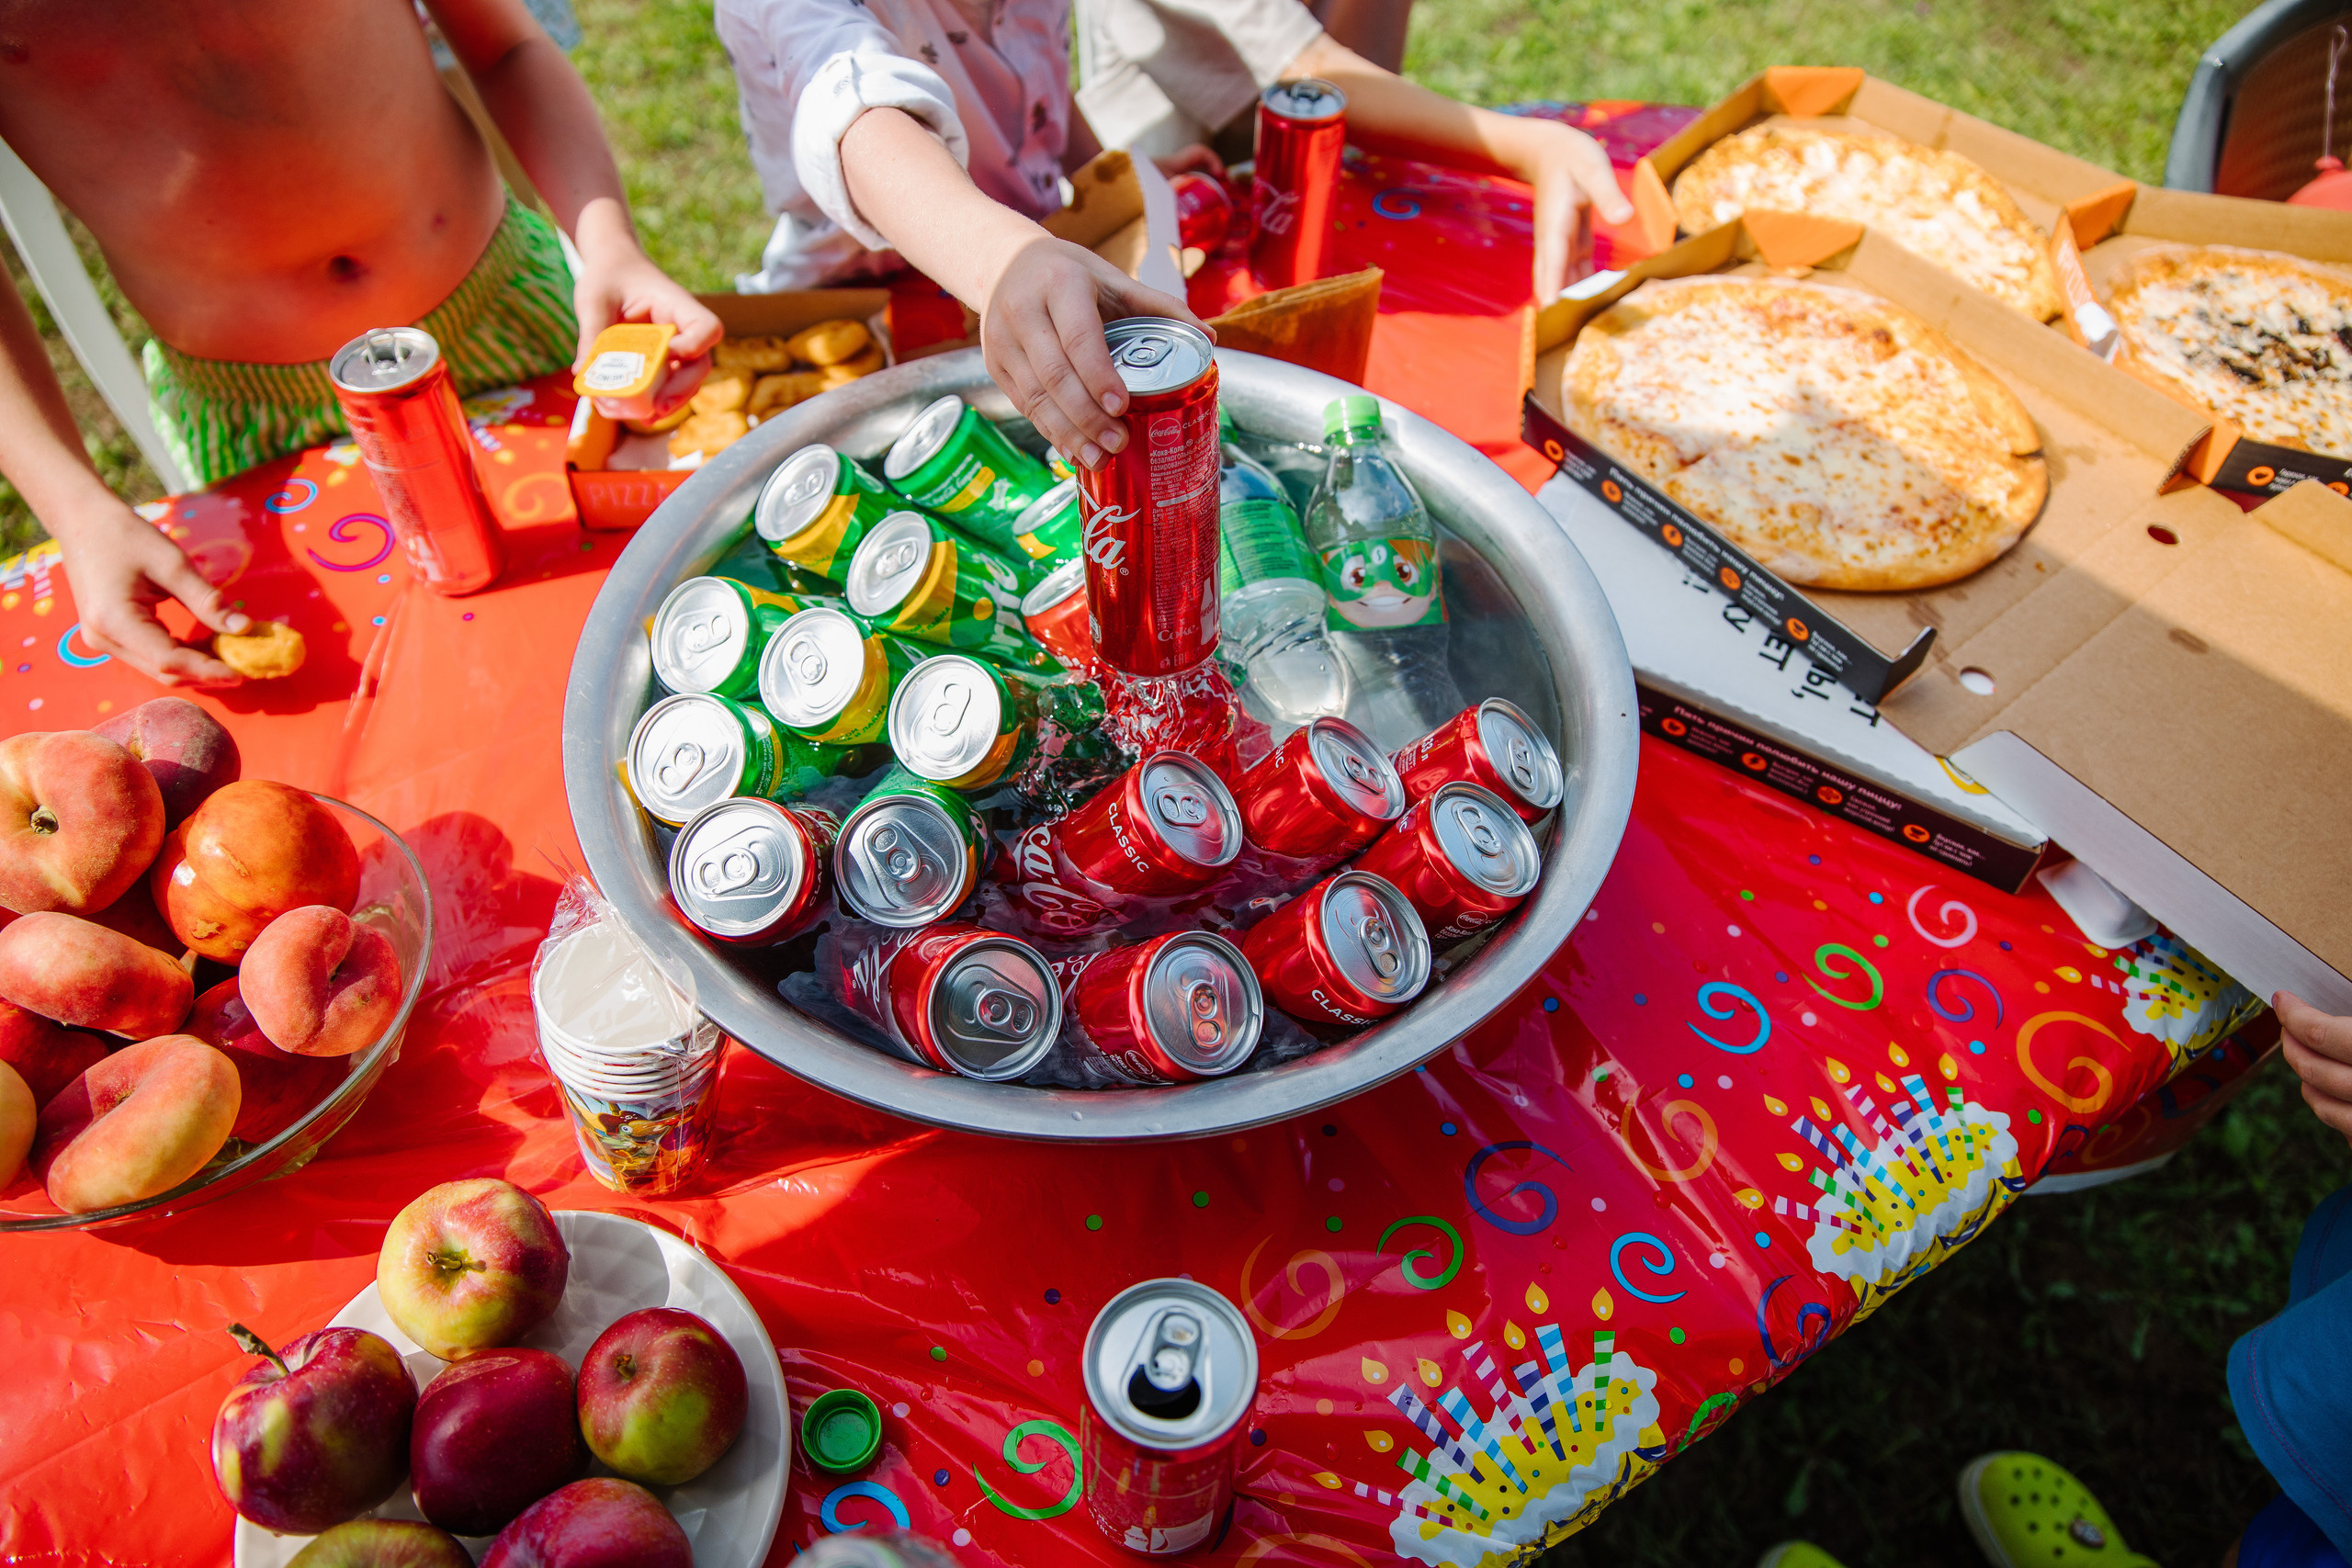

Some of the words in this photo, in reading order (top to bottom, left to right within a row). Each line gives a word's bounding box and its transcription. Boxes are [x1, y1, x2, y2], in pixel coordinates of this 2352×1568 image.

[1670, 513, 1721, 554] полюбить
[1706, 720, 1756, 747] причин
[1755, 741, 1820, 775] полюбить
[1820, 771, 1857, 792] нашу
[1857, 786, 1904, 812] пиццу:
[1108, 802, 1150, 874] CLASSIC
